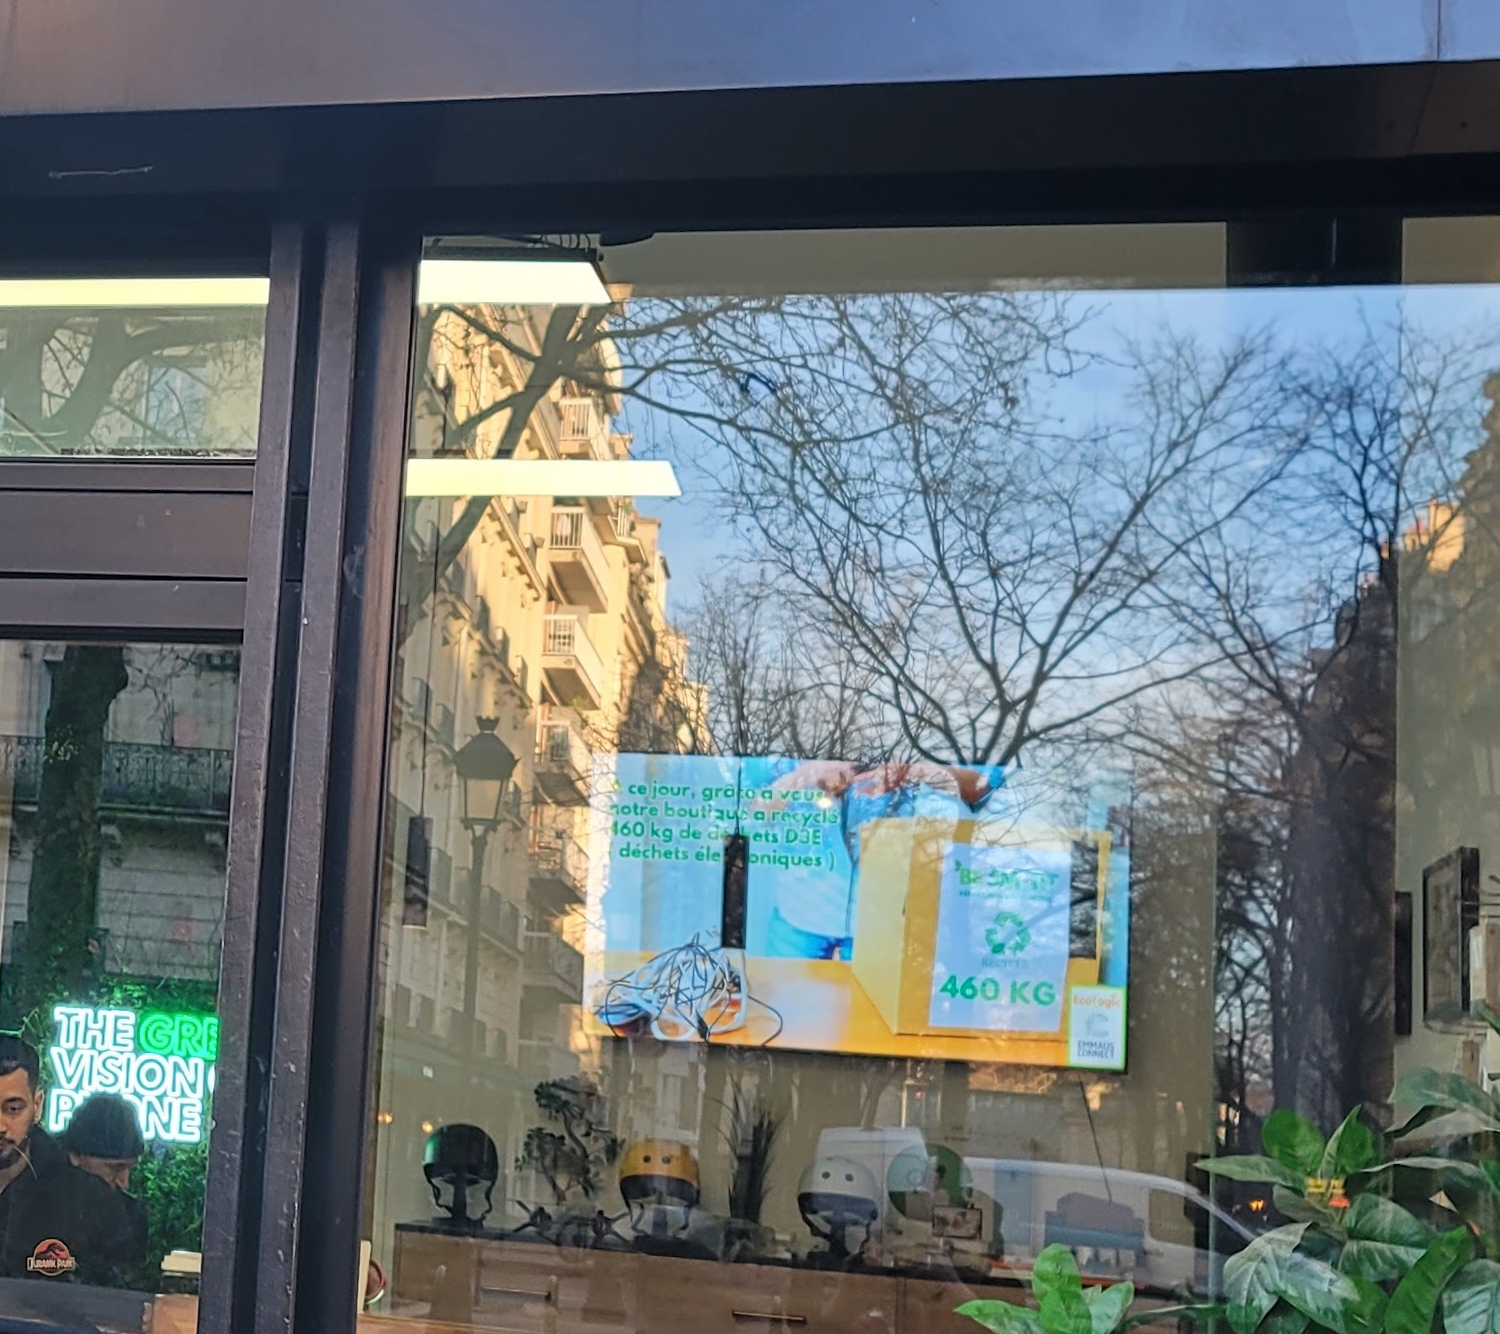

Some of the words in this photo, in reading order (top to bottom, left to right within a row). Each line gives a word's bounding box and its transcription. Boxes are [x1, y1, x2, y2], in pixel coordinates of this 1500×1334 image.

[627, 783, 647, 796] ce
[652, 780, 695, 800] jour,
[651, 821, 673, 843] kg
[679, 822, 702, 841] de
[707, 824, 779, 844] déhets
[753, 809, 766, 822] a
[771, 808, 839, 828] recyclé
[619, 842, 689, 860] déchets
[694, 843, 822, 870] éleoniques
[939, 975, 1001, 1001] 460
[1010, 979, 1057, 1007] KG
[53, 1006, 136, 1052] THE
[50, 1046, 204, 1100] VISION
[49, 1087, 203, 1144] PNE
